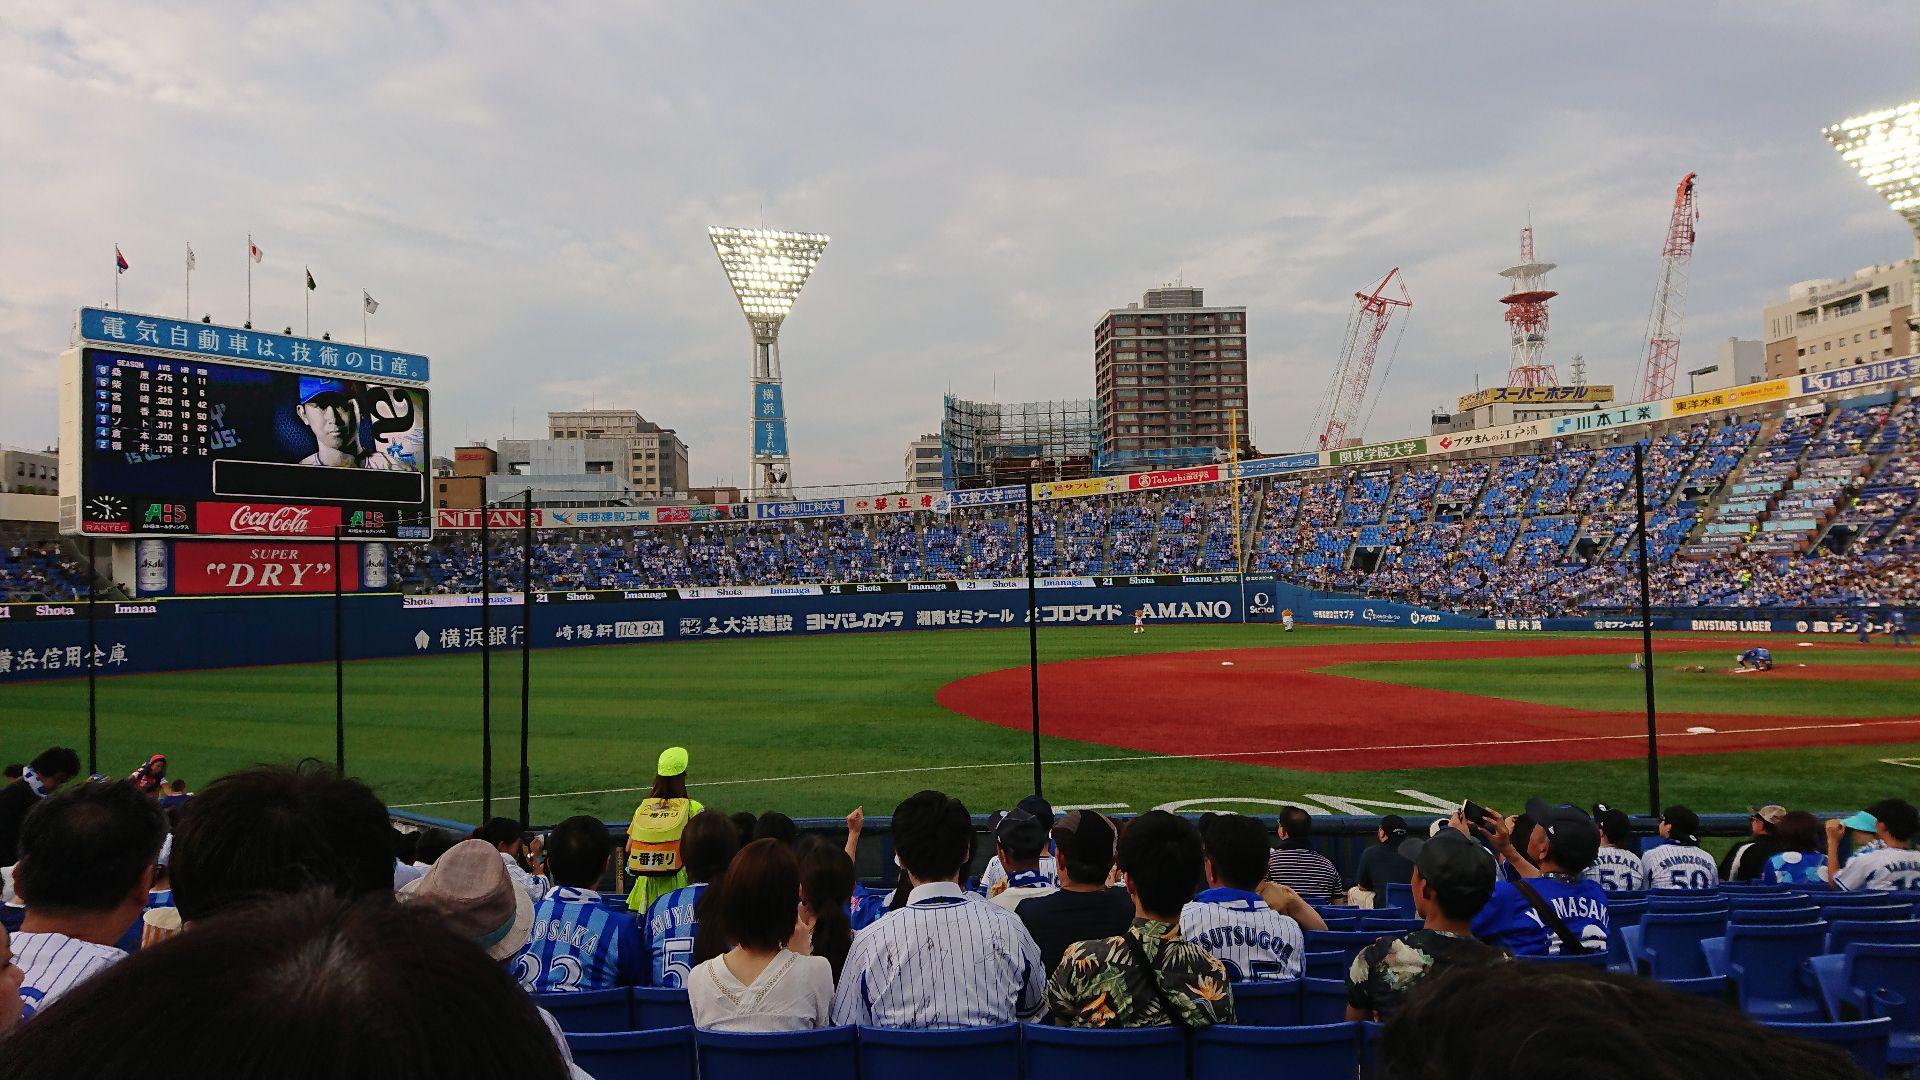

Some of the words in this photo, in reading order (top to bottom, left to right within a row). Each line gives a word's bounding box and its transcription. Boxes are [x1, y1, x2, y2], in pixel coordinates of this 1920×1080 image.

[103, 316, 417, 377] 電気自動車は、技術の日産。
[117, 360, 144, 369] SEASON
[158, 364, 171, 372] AVG
[181, 366, 190, 374] HR
[1836, 361, 1920, 386] 神奈川大学
[156, 373, 173, 382] .275
[183, 376, 188, 384] 4
[1807, 374, 1831, 391] KU
[156, 386, 173, 394] .215
[200, 389, 205, 397] 6
[1494, 386, 1588, 400] スーパーホテル
[156, 397, 173, 406] .320
[198, 401, 207, 409] 42
[762, 388, 775, 415] 横浜
[1675, 395, 1724, 412] 東洋水産
[197, 413, 207, 421] 50
[1576, 406, 1652, 430] 川本工業
[156, 422, 173, 430] .317
[197, 424, 207, 432] 26
[183, 435, 188, 443] 0
[766, 422, 775, 448] 生まれ
[1453, 426, 1538, 447] ブタまんの江戸清
[100, 441, 107, 449] 2
[156, 446, 173, 454] .176
[183, 447, 188, 455] 2
[198, 448, 207, 456] 12
[1339, 441, 1417, 464] 関東学院大学
[1151, 472, 1210, 484] Takashimaya
[958, 489, 1003, 505] 文教大学
[778, 502, 840, 512] 神奈川工科大学
[230, 505, 312, 533] Coca-Cola
[439, 511, 521, 527] NITTAN
[576, 511, 650, 522] 東亜建設工業
[250, 549, 299, 560] SUPER
[966, 581, 976, 589] 21
[992, 580, 1017, 588] Shota
[1042, 578, 1083, 587] Imanaga
[1102, 577, 1114, 586] 21
[1129, 576, 1155, 585] Shota
[1182, 575, 1212, 583] Imana
[688, 590, 700, 598] 21
[717, 588, 743, 597] Shota
[770, 587, 811, 596] Imanaga
[830, 586, 841, 594] 21
[856, 584, 881, 592] Shota
[907, 583, 947, 592] Imanaga
[403, 597, 433, 606] Shota
[535, 594, 549, 603] 21
[566, 592, 595, 602] Shota
[624, 591, 667, 600] Imanaga
[36, 605, 76, 616] Shota
[115, 604, 157, 614] Imana
[1041, 604, 1122, 622] コロワイド
[1142, 600, 1232, 619] AMANO
[723, 614, 793, 634] 大洋建設
[806, 610, 904, 631] ヨドバシカメラ
[916, 608, 1015, 626] 湘南ゼミナール
[556, 623, 614, 641] 崎陽軒
[1495, 619, 1542, 631] 県民共済
[1691, 620, 1737, 632] BAYSTARS
[1740, 620, 1772, 632] LAGER
[440, 625, 524, 649] 横浜銀行
[631, 852, 675, 866] 一番搾り
[651, 904, 700, 937] MIYA
